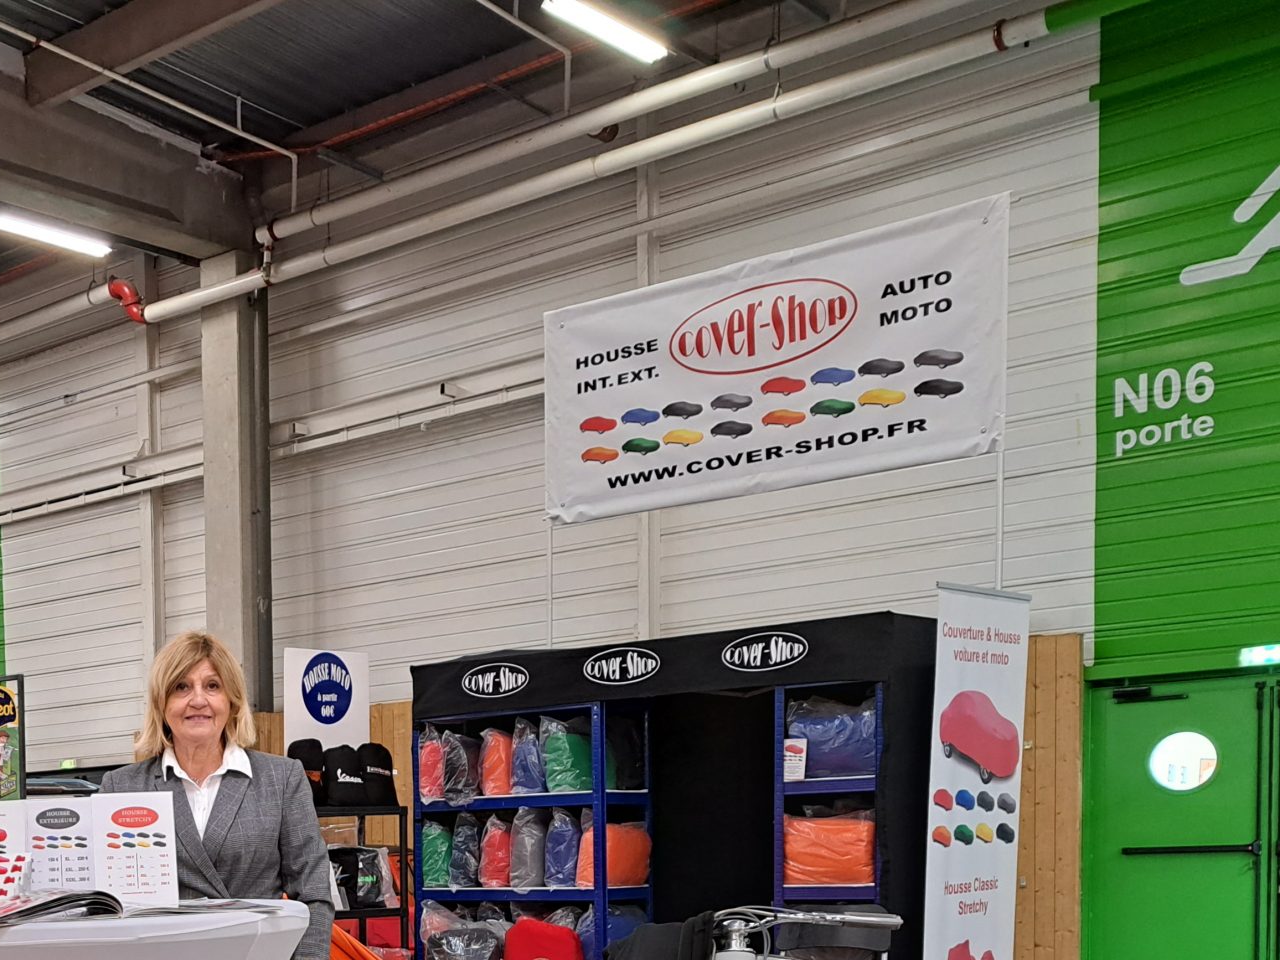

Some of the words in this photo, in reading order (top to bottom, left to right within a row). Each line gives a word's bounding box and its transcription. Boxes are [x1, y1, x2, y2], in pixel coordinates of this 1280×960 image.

[880, 269, 953, 299] AUTO
[879, 297, 953, 327] MOTO
[575, 338, 660, 370] HOUSSE
[576, 376, 614, 395] INT.
[617, 366, 660, 387] EXT.
[1114, 361, 1215, 418] N06
[1116, 413, 1215, 457] porte
[943, 622, 984, 641] Couverture
[986, 627, 992, 642] &
[995, 628, 1021, 645] Housse
[953, 647, 980, 663] voiture
[981, 650, 989, 664] et
[990, 651, 1009, 666] moto
[304, 663, 329, 694] HOUSSE
[331, 663, 350, 691] MOTO
[321, 705, 335, 717] 60€
[944, 880, 972, 895] Housse
[973, 876, 999, 892] Classic
[958, 900, 989, 916] Stretchy
